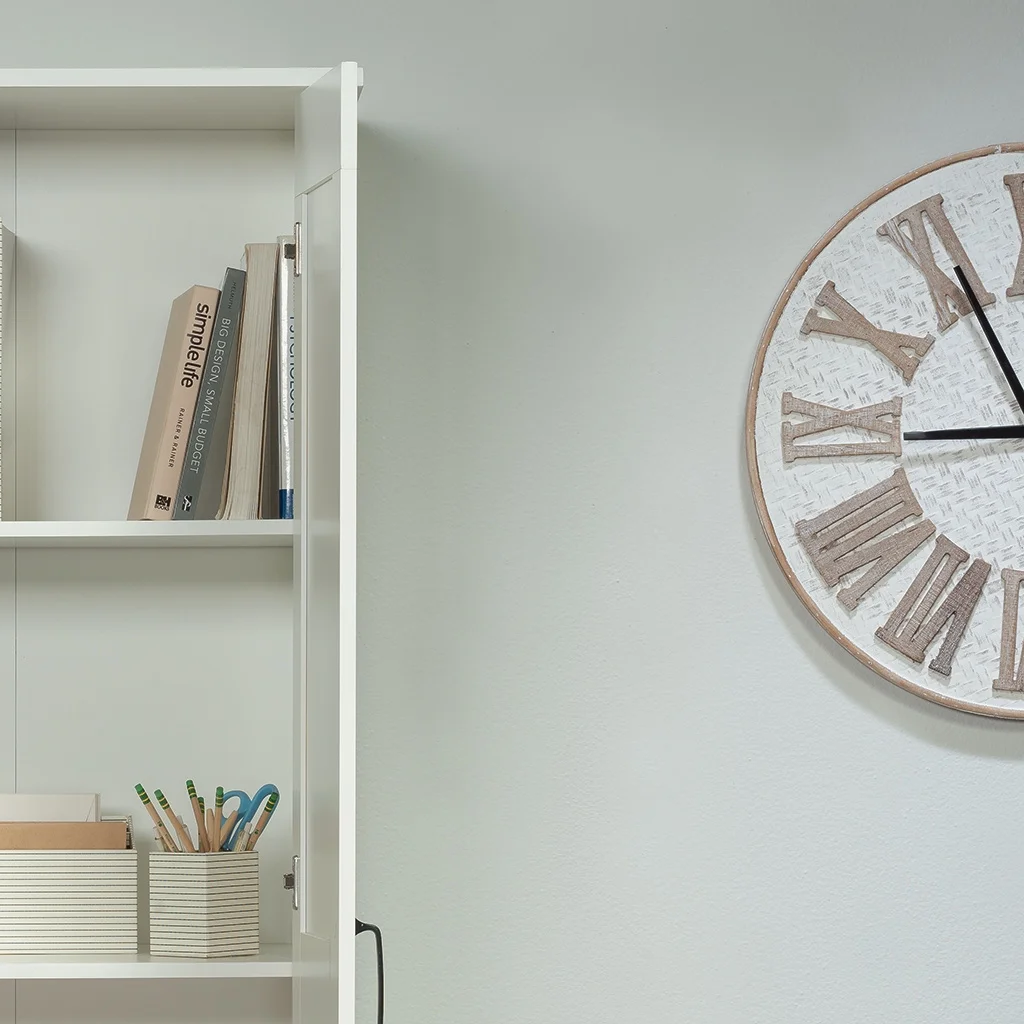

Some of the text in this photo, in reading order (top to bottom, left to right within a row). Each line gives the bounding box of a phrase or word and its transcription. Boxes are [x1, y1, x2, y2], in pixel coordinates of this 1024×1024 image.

[877, 193, 996, 333] XI
[800, 280, 936, 385] X
[176, 407, 185, 434] RAINER
[190, 318, 231, 474] BIG DESIGN, SMALL BUDGET
[168, 442, 178, 468] RAINER
